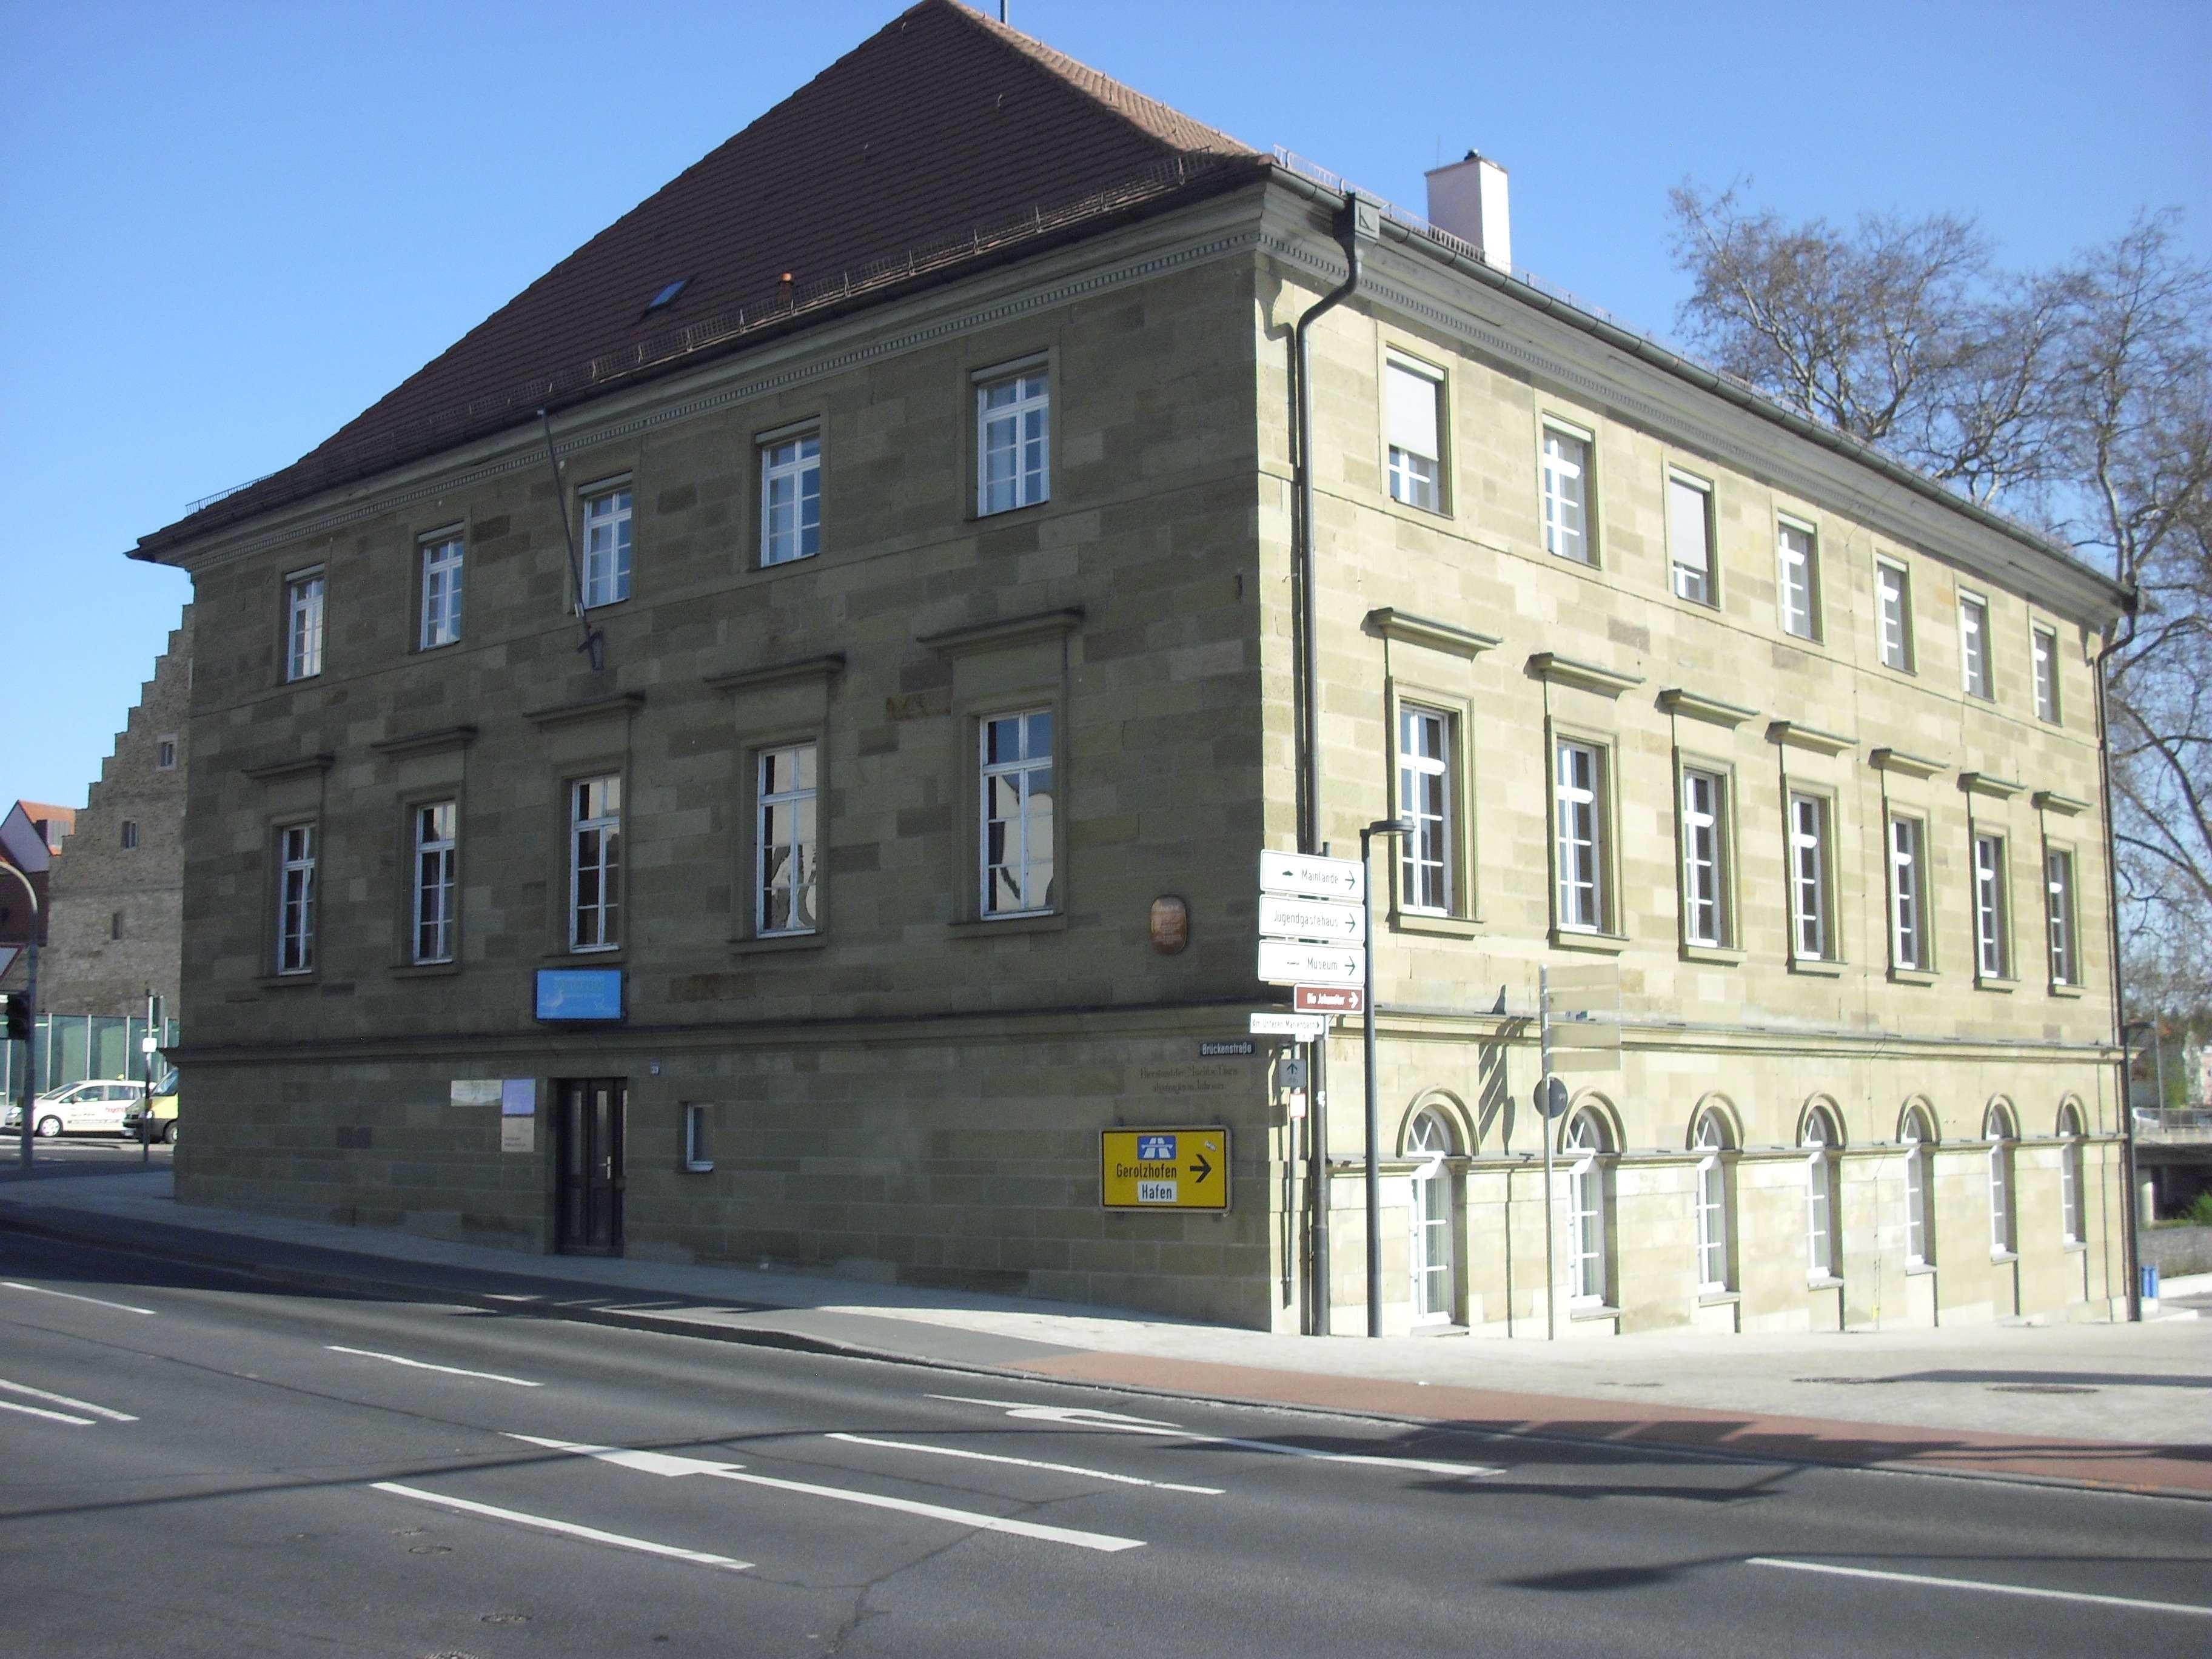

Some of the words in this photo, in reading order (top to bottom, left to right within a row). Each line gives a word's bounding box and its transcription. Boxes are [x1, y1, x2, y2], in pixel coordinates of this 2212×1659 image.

[1307, 957, 1338, 971] Museum
[1116, 1163, 1177, 1179] Gerolzhofen
[1142, 1185, 1172, 1200] Hafen
